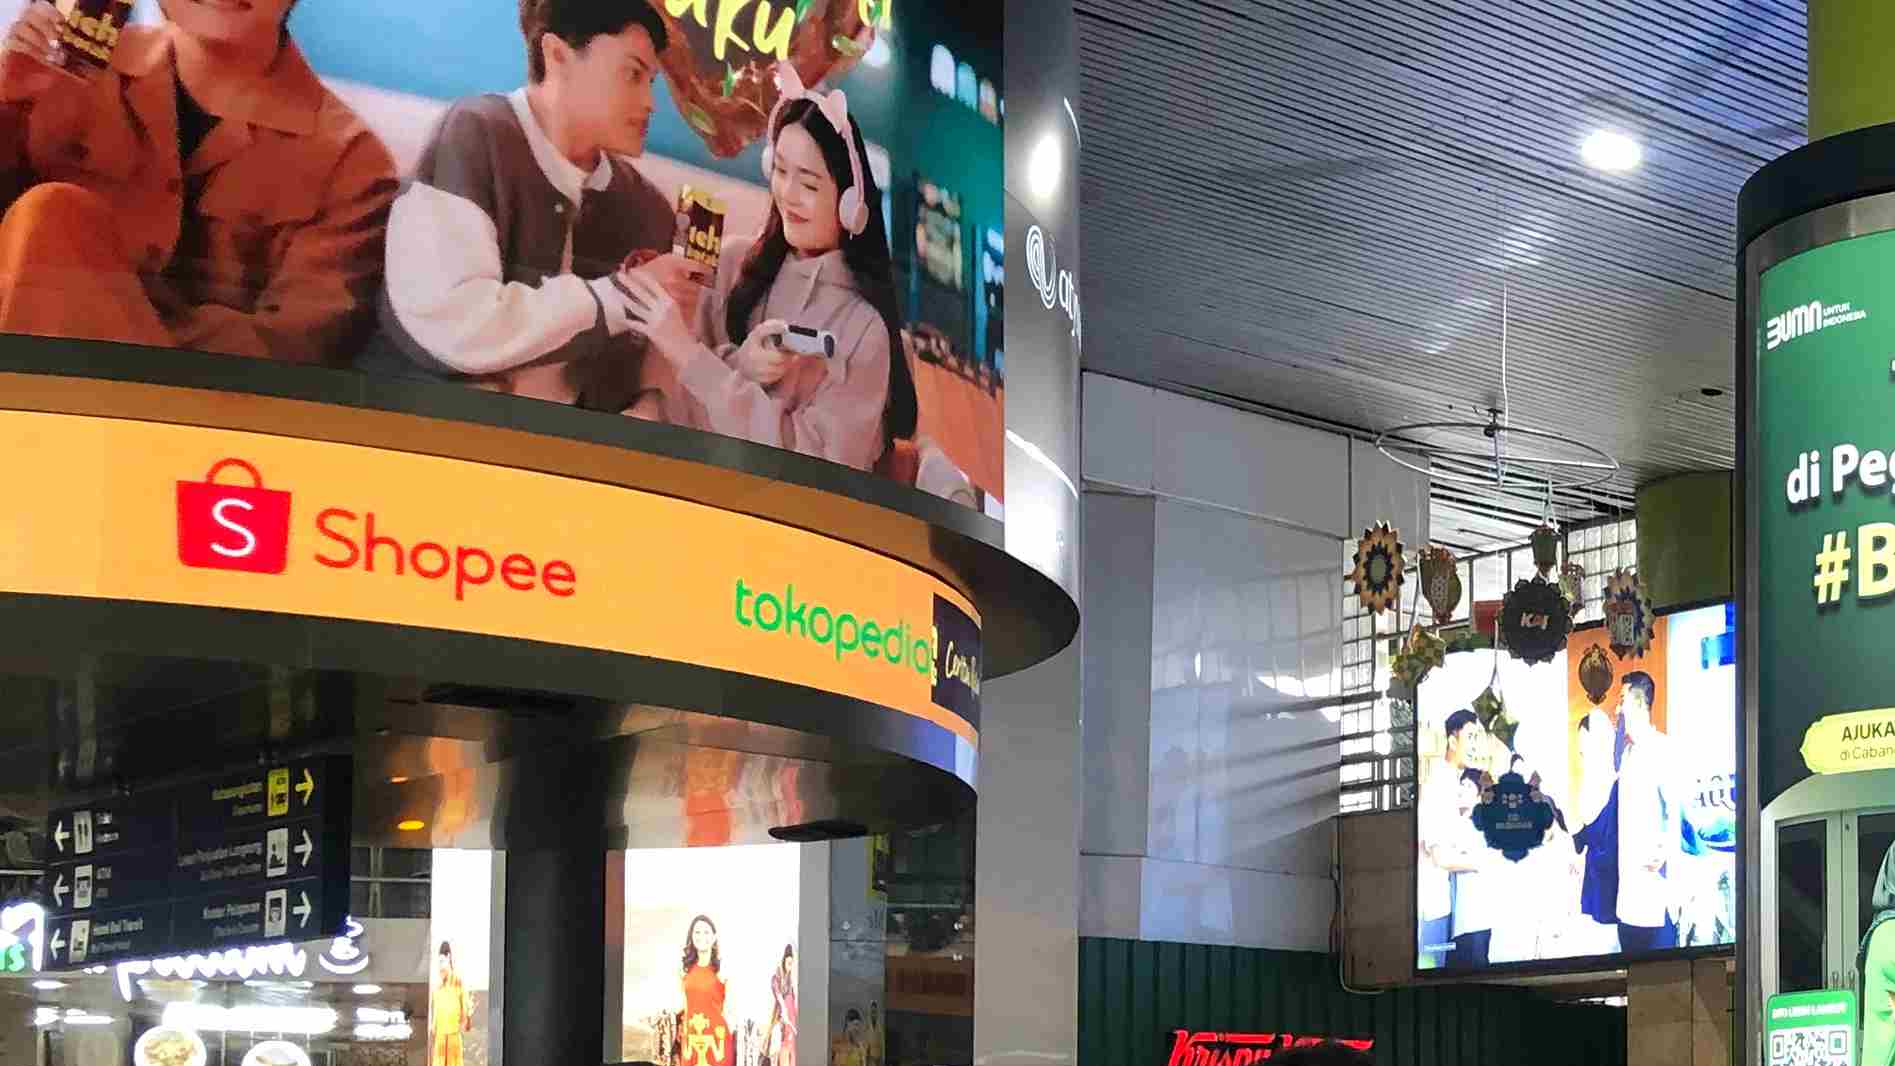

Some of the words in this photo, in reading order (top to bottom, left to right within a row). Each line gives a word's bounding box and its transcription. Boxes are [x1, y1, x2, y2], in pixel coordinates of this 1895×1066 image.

[1786, 449, 1820, 504] di
[210, 498, 256, 558] S
[314, 507, 577, 601] Shopee
[735, 577, 931, 674] tokopedia
